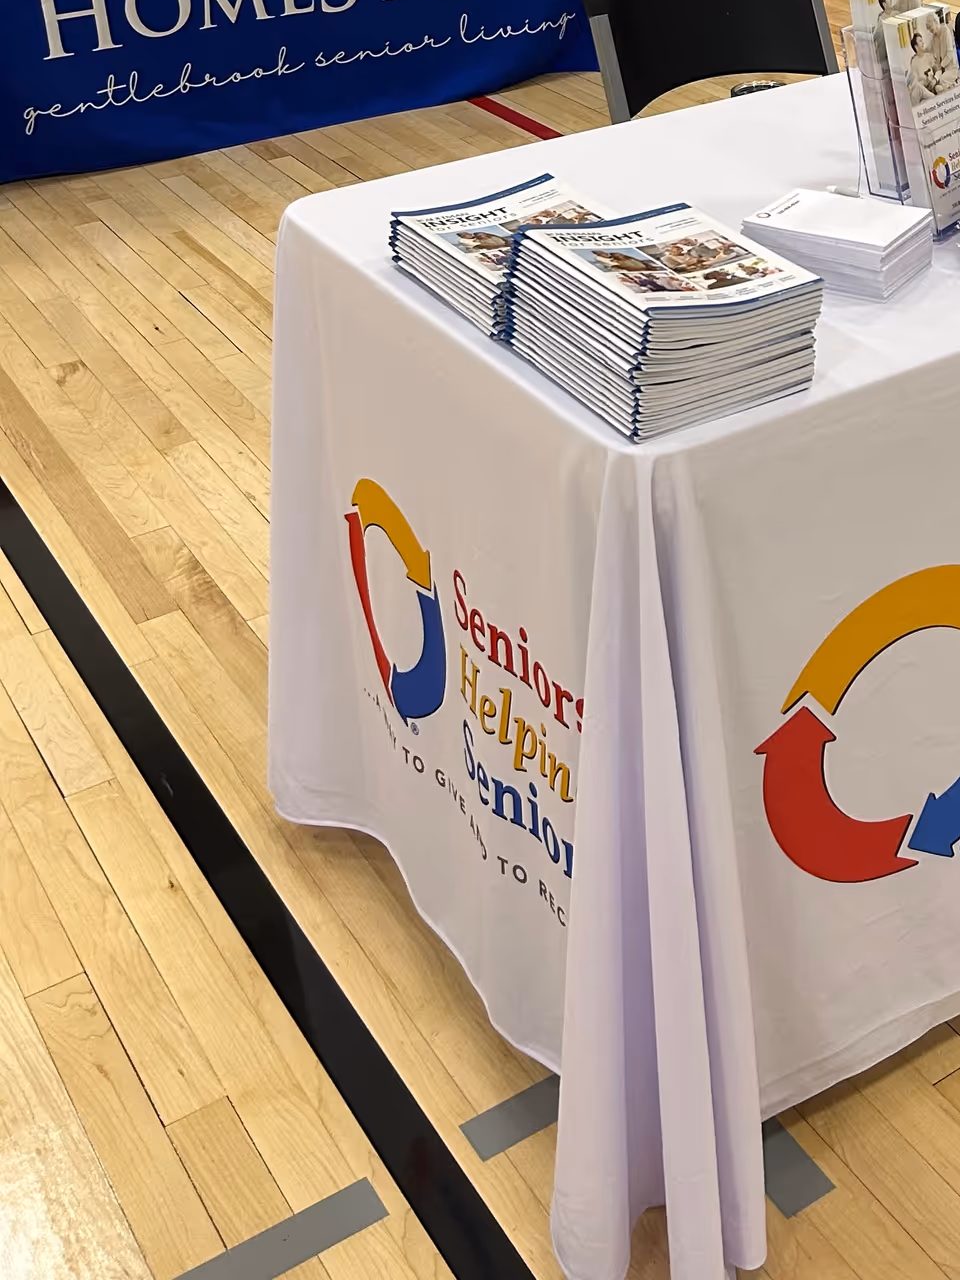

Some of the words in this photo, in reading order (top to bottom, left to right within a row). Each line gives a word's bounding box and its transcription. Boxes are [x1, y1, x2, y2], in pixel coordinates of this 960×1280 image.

[23, 45, 305, 136] gentlebrook
[314, 33, 452, 70] senior
[458, 11, 577, 46] living
[421, 206, 508, 229] INSIGHT
[460, 211, 517, 229] seniors
[551, 230, 643, 243] INSIGHT
[597, 237, 654, 247] seniors
[402, 746, 425, 774] TO
[435, 768, 467, 815] GIVE
[497, 855, 528, 884] TO
